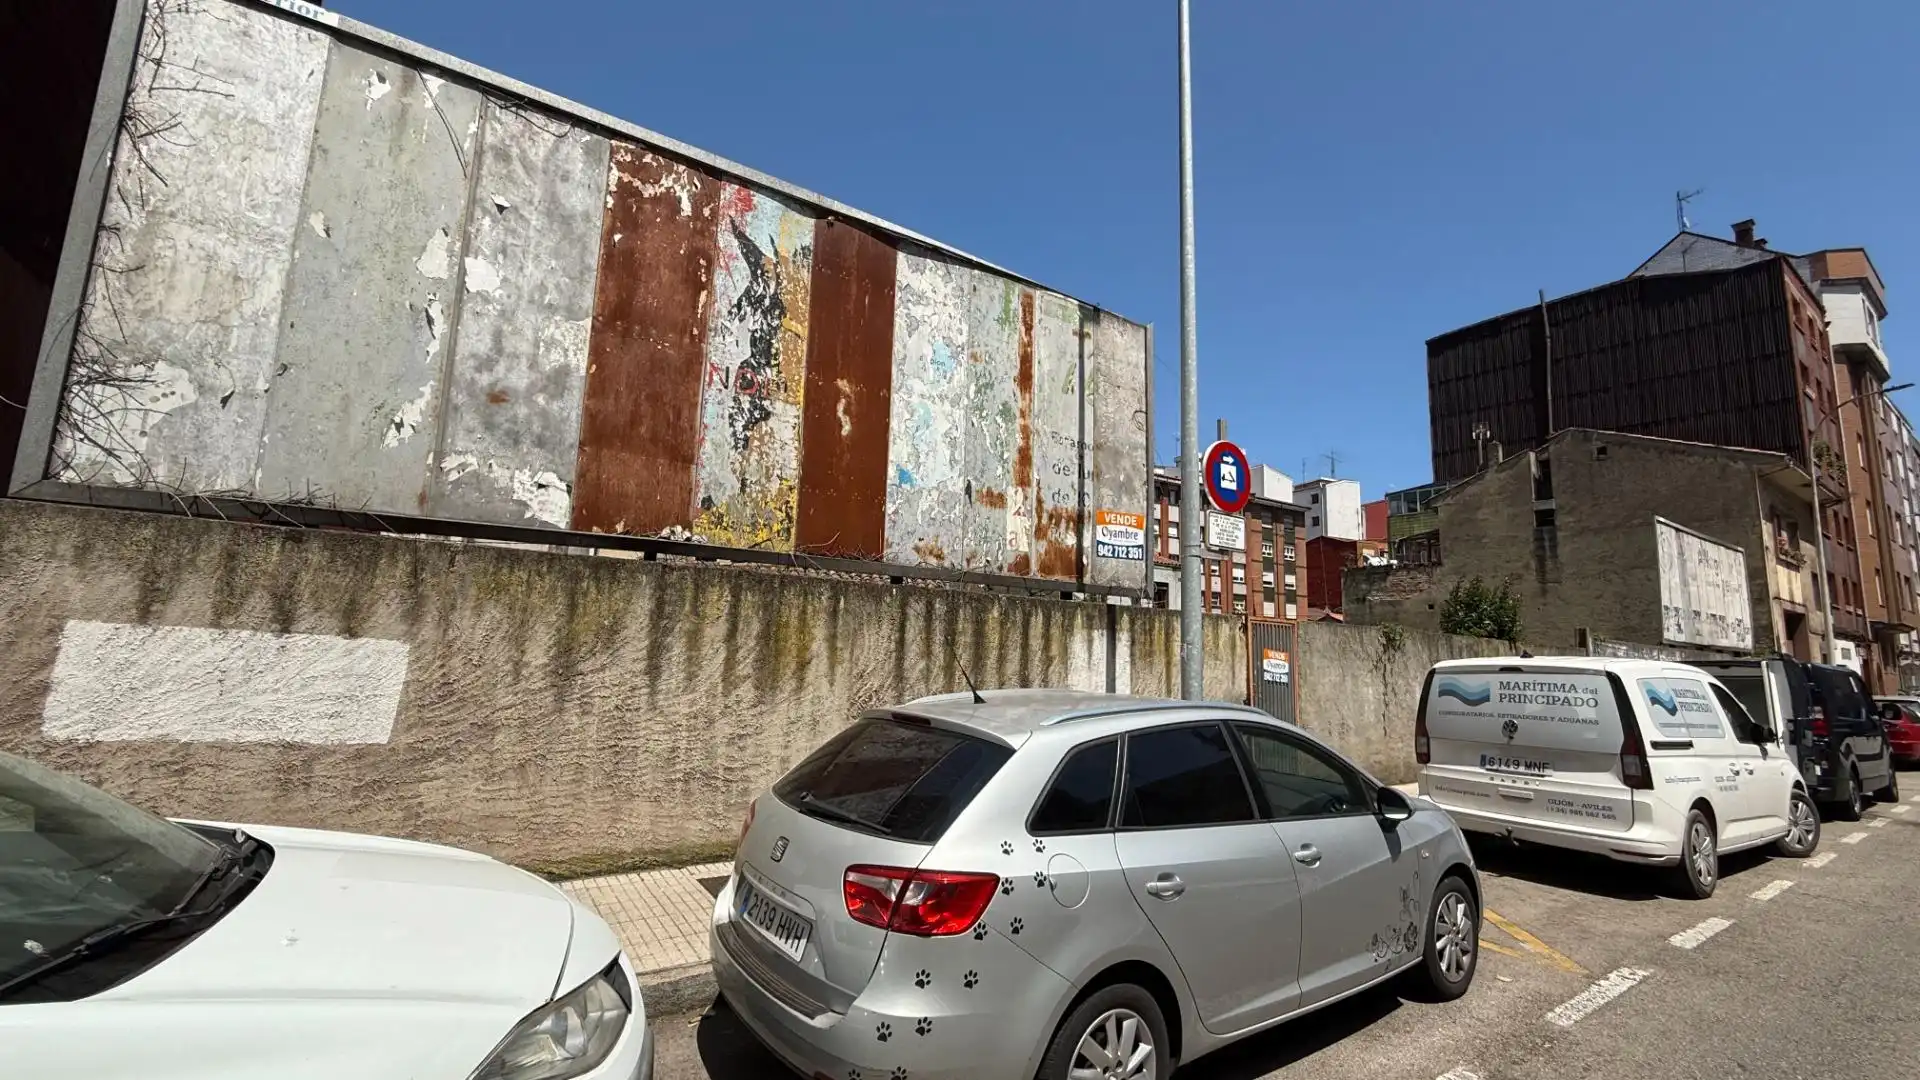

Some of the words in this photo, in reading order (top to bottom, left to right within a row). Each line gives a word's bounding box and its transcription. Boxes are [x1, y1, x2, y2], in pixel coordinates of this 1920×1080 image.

[264, 0, 325, 18] rior
[1104, 512, 1138, 526] VENDE
[1101, 526, 1139, 540] Oyambre
[1097, 544, 1113, 557] 942
[1114, 546, 1127, 558] 712
[1128, 547, 1143, 560] 351
[1498, 679, 1578, 694] MARÍTIMA
[1582, 687, 1599, 695] del
[1498, 693, 1599, 708] PRINCIPADO
[1557, 717, 1600, 725] ADUANAS
[1488, 756, 1520, 770] 6149
[1524, 760, 1551, 773] MNF
[747, 892, 777, 931] 2139
[775, 911, 806, 953] HVH
